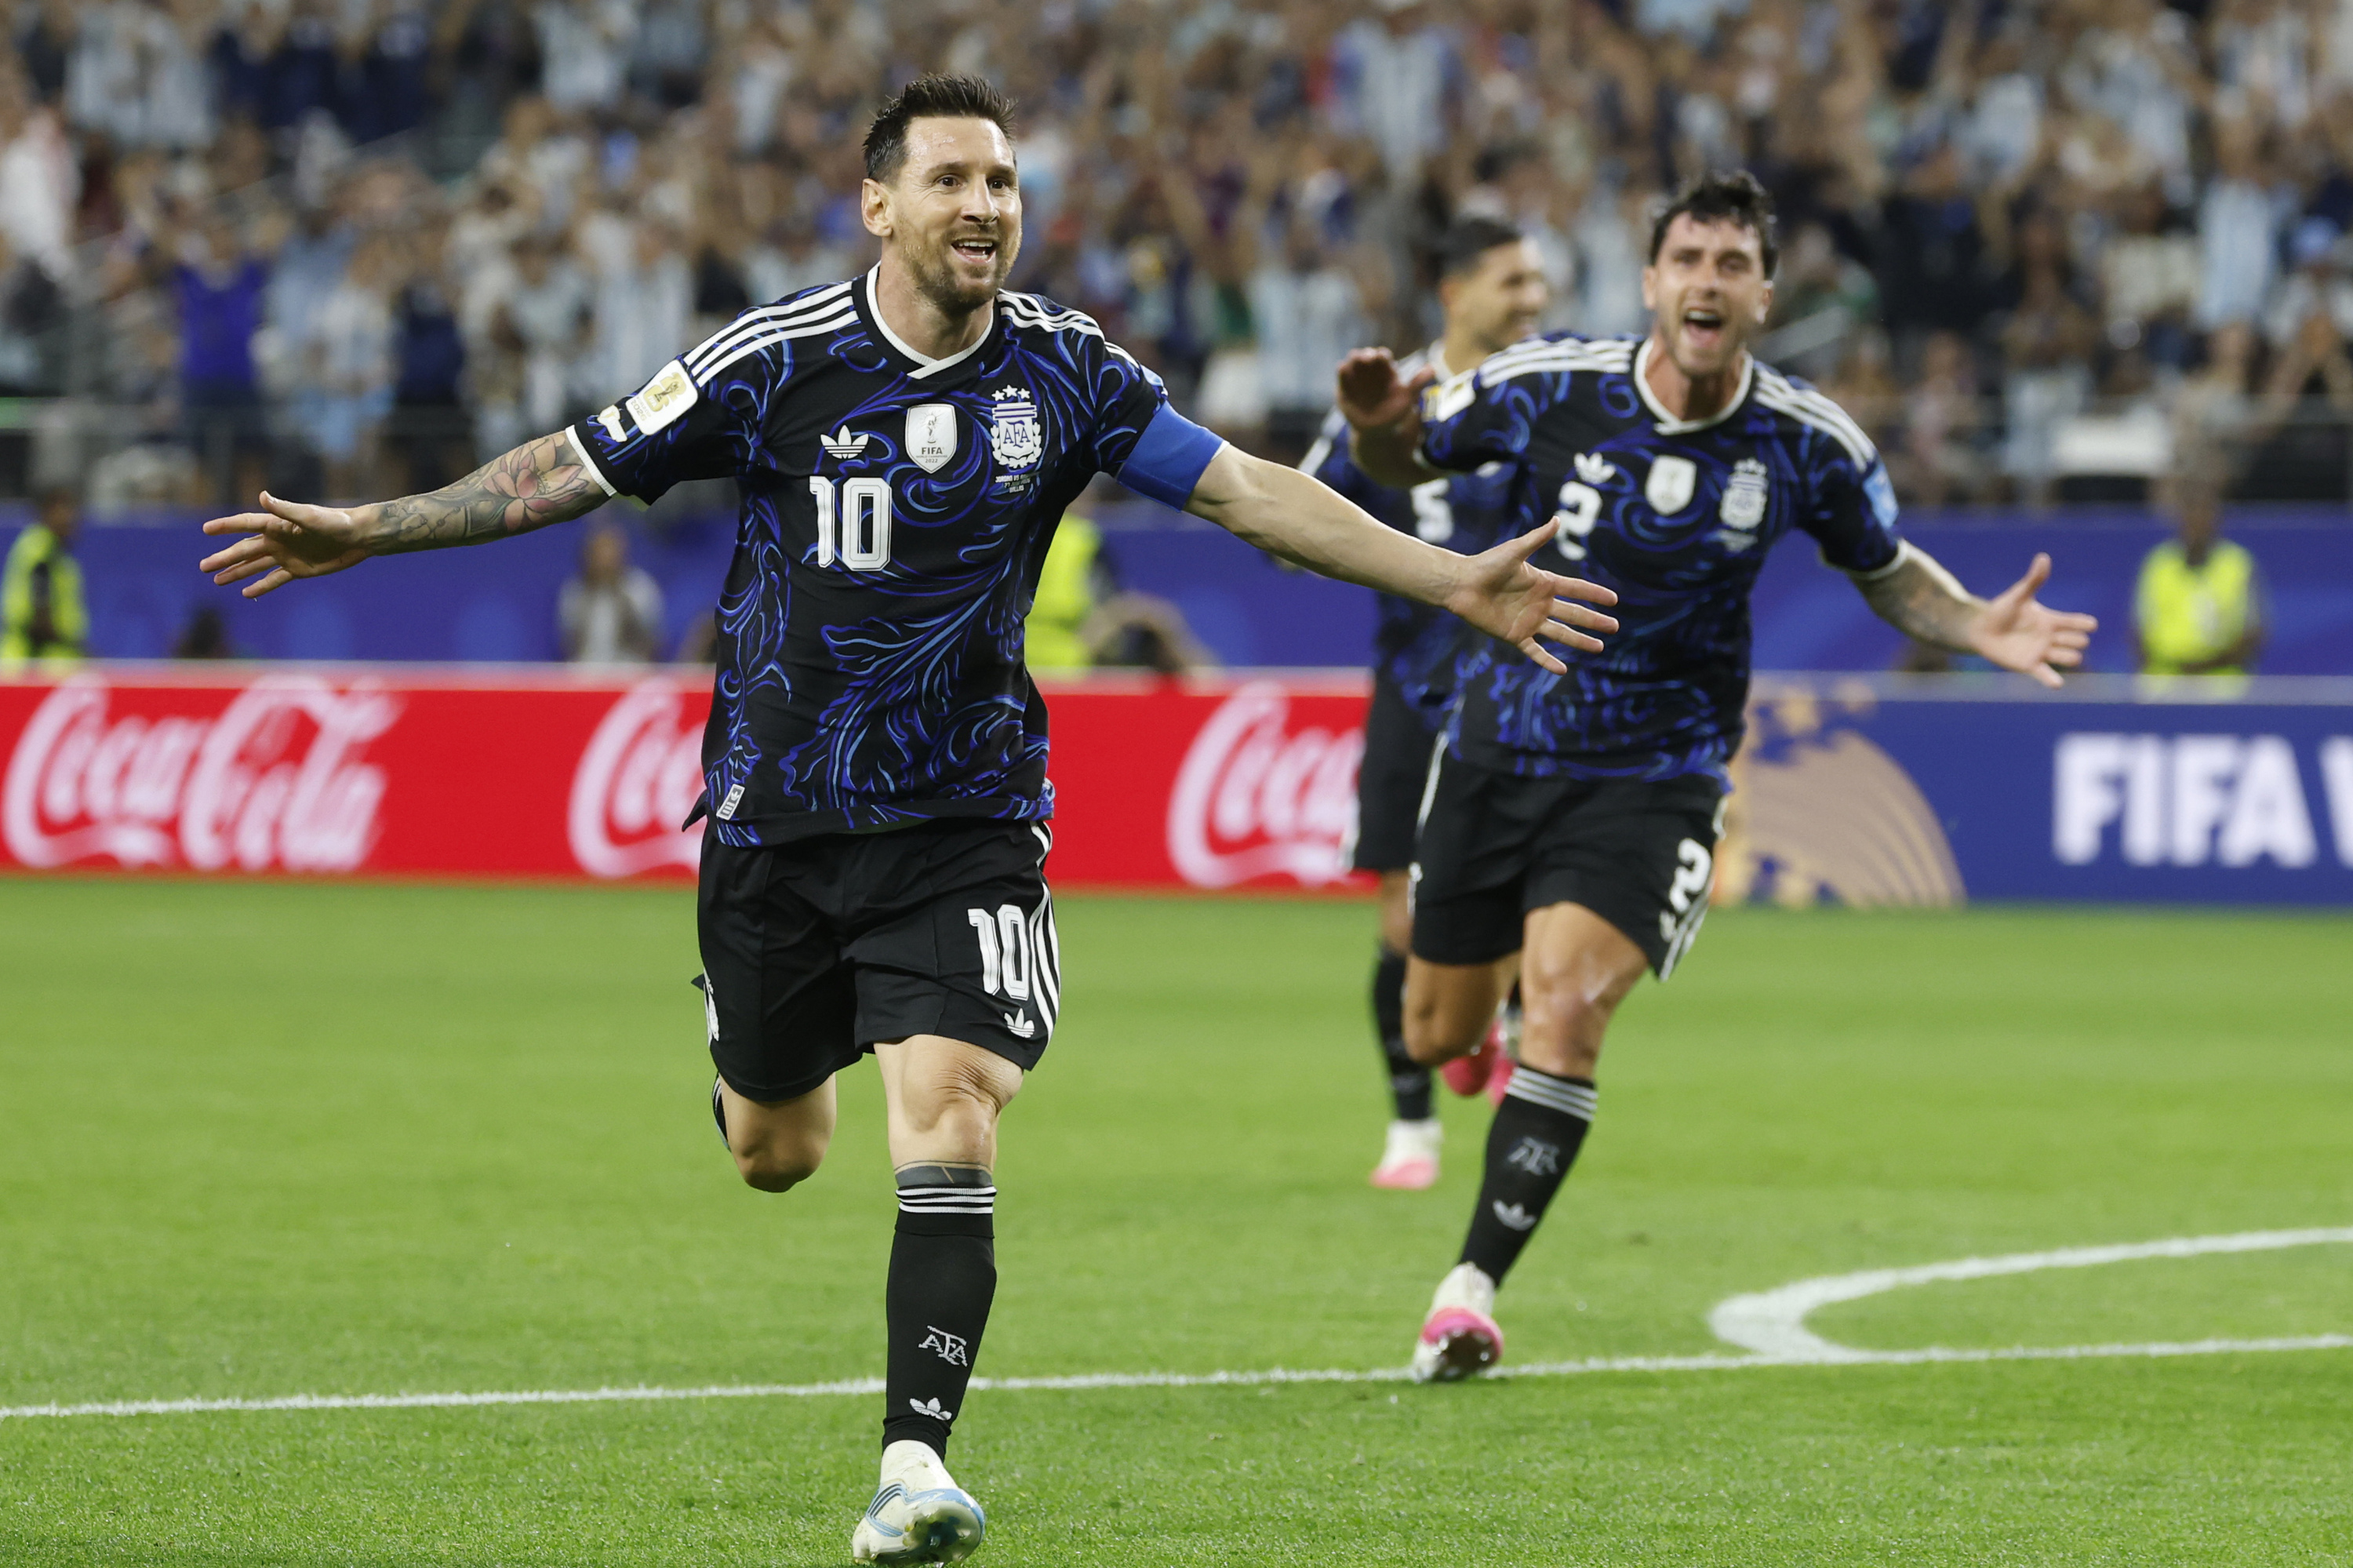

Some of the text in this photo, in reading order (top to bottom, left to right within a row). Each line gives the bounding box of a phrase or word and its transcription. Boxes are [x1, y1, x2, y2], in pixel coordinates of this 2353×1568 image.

[922, 446, 943, 455] FIFA
[1003, 420, 1031, 448] AFA
[809, 476, 893, 571] 10
[1410, 478, 1453, 543] 5
[1555, 481, 1602, 560] 2
[2053, 732, 2318, 868] FIFA
[1669, 837, 1711, 913] 2
[968, 904, 1031, 1001] 10
[918, 1325, 968, 1367] AFA
